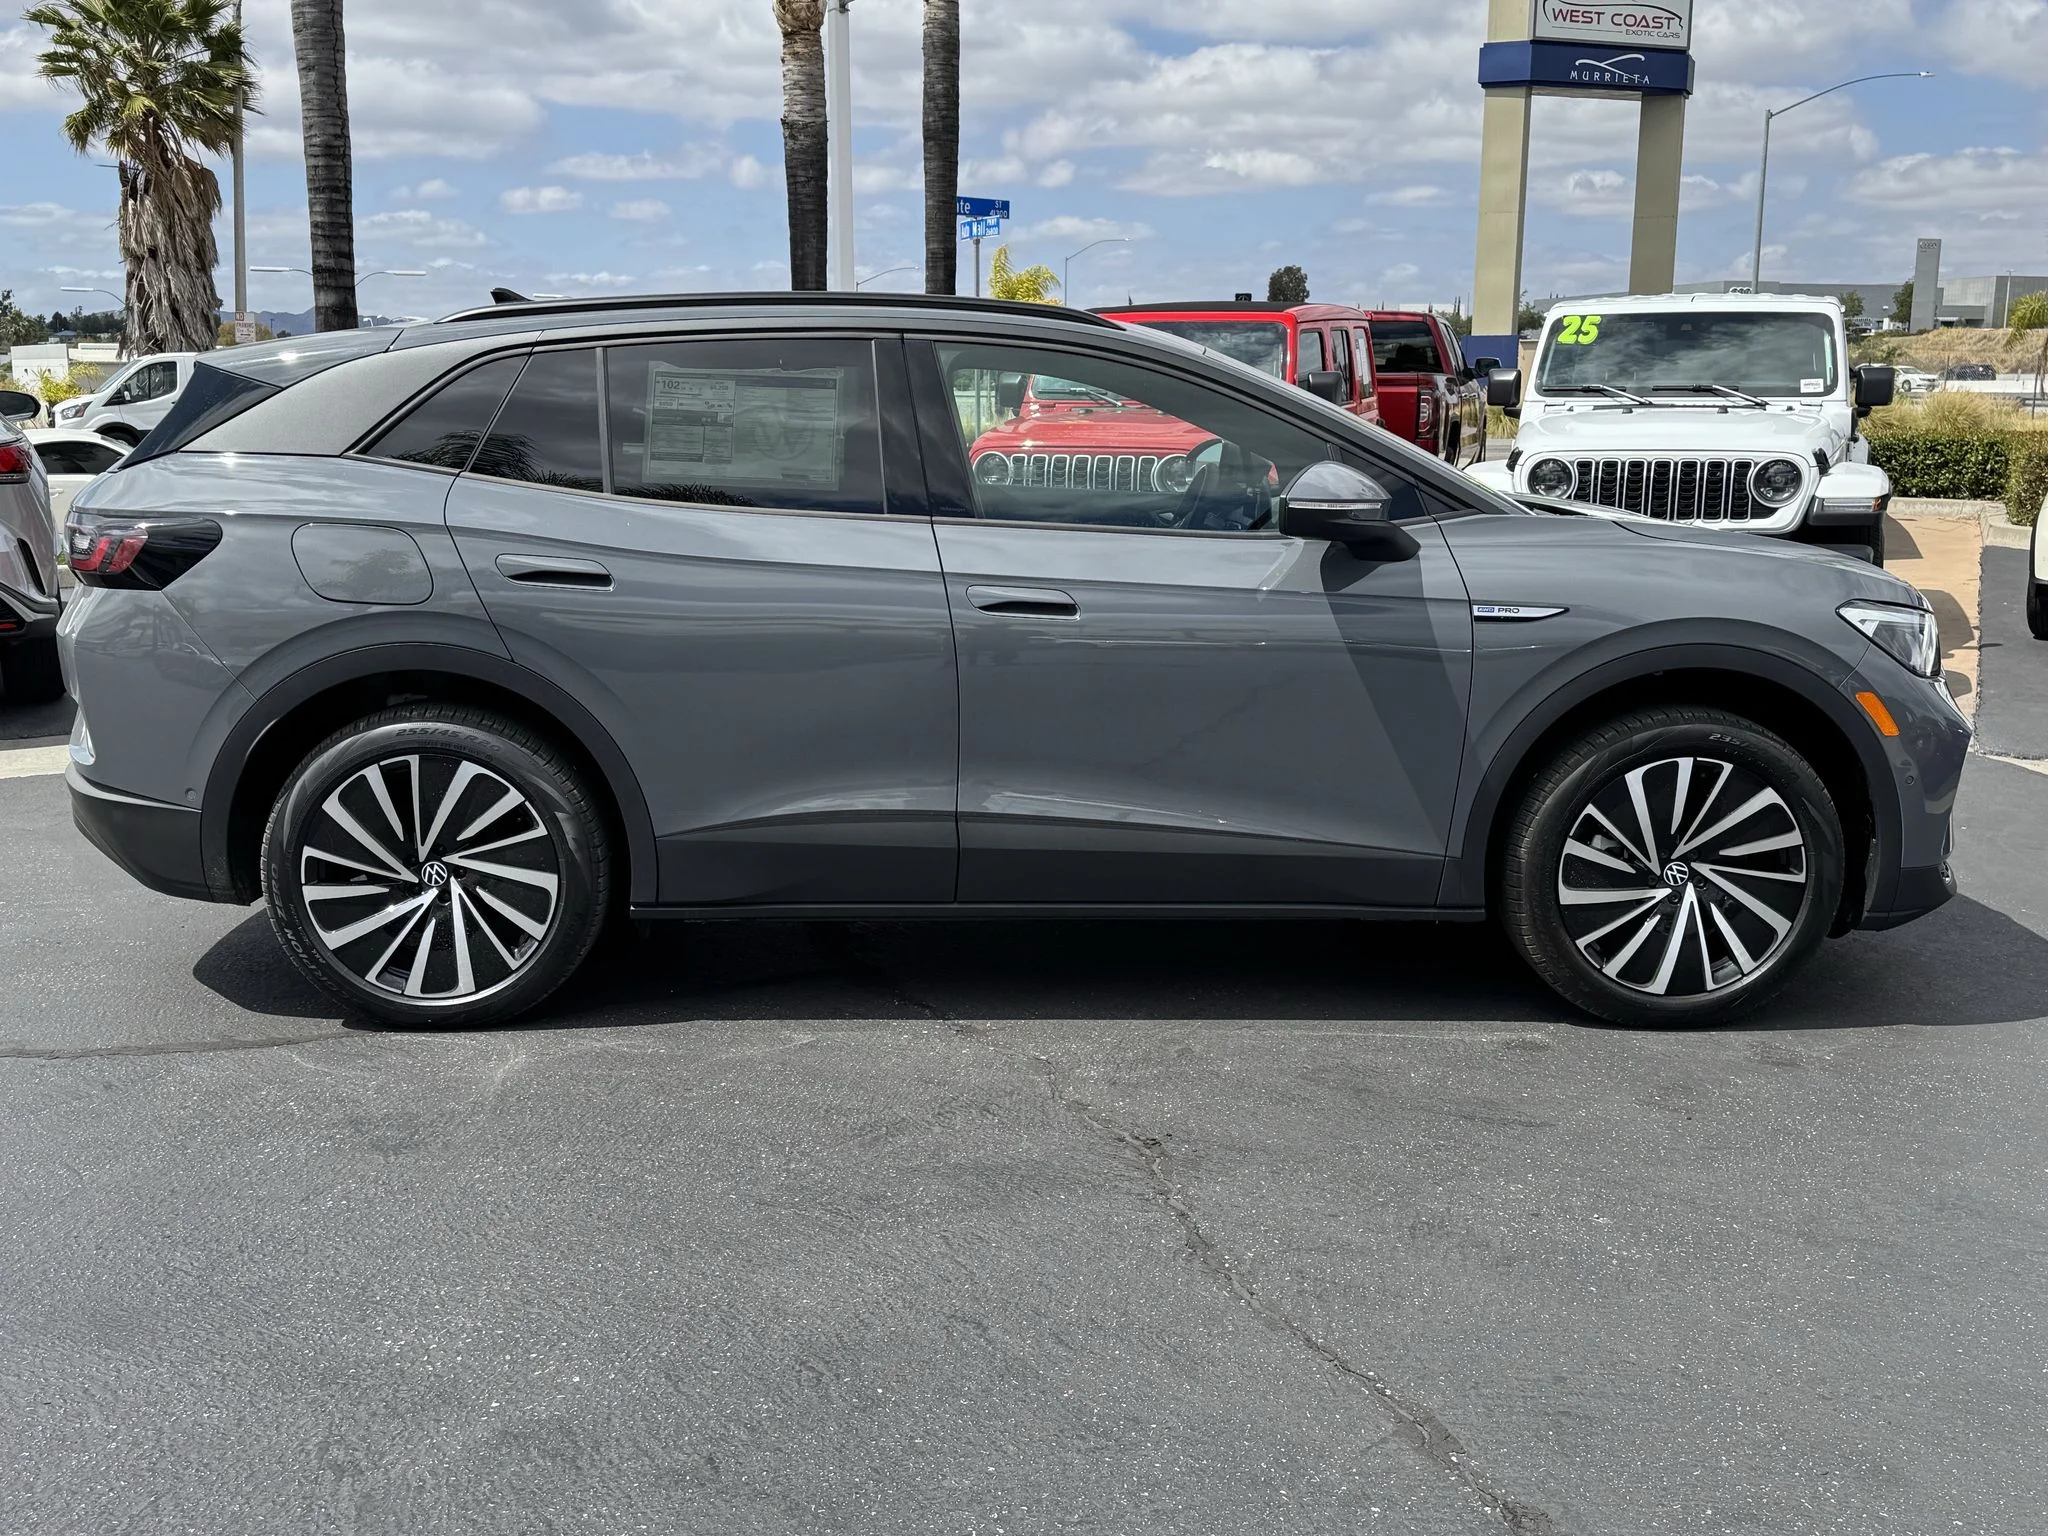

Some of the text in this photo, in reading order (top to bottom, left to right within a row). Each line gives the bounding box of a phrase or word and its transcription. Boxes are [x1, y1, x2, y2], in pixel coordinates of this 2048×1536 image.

[1552, 8, 1676, 30] WEST COAST
[1625, 29, 1655, 37] EXOTIC
[1569, 70, 1650, 85] MURRIETA
[1557, 315, 1602, 345] 25
[661, 380, 680, 390] 102
[395, 728, 462, 738] 255/45
